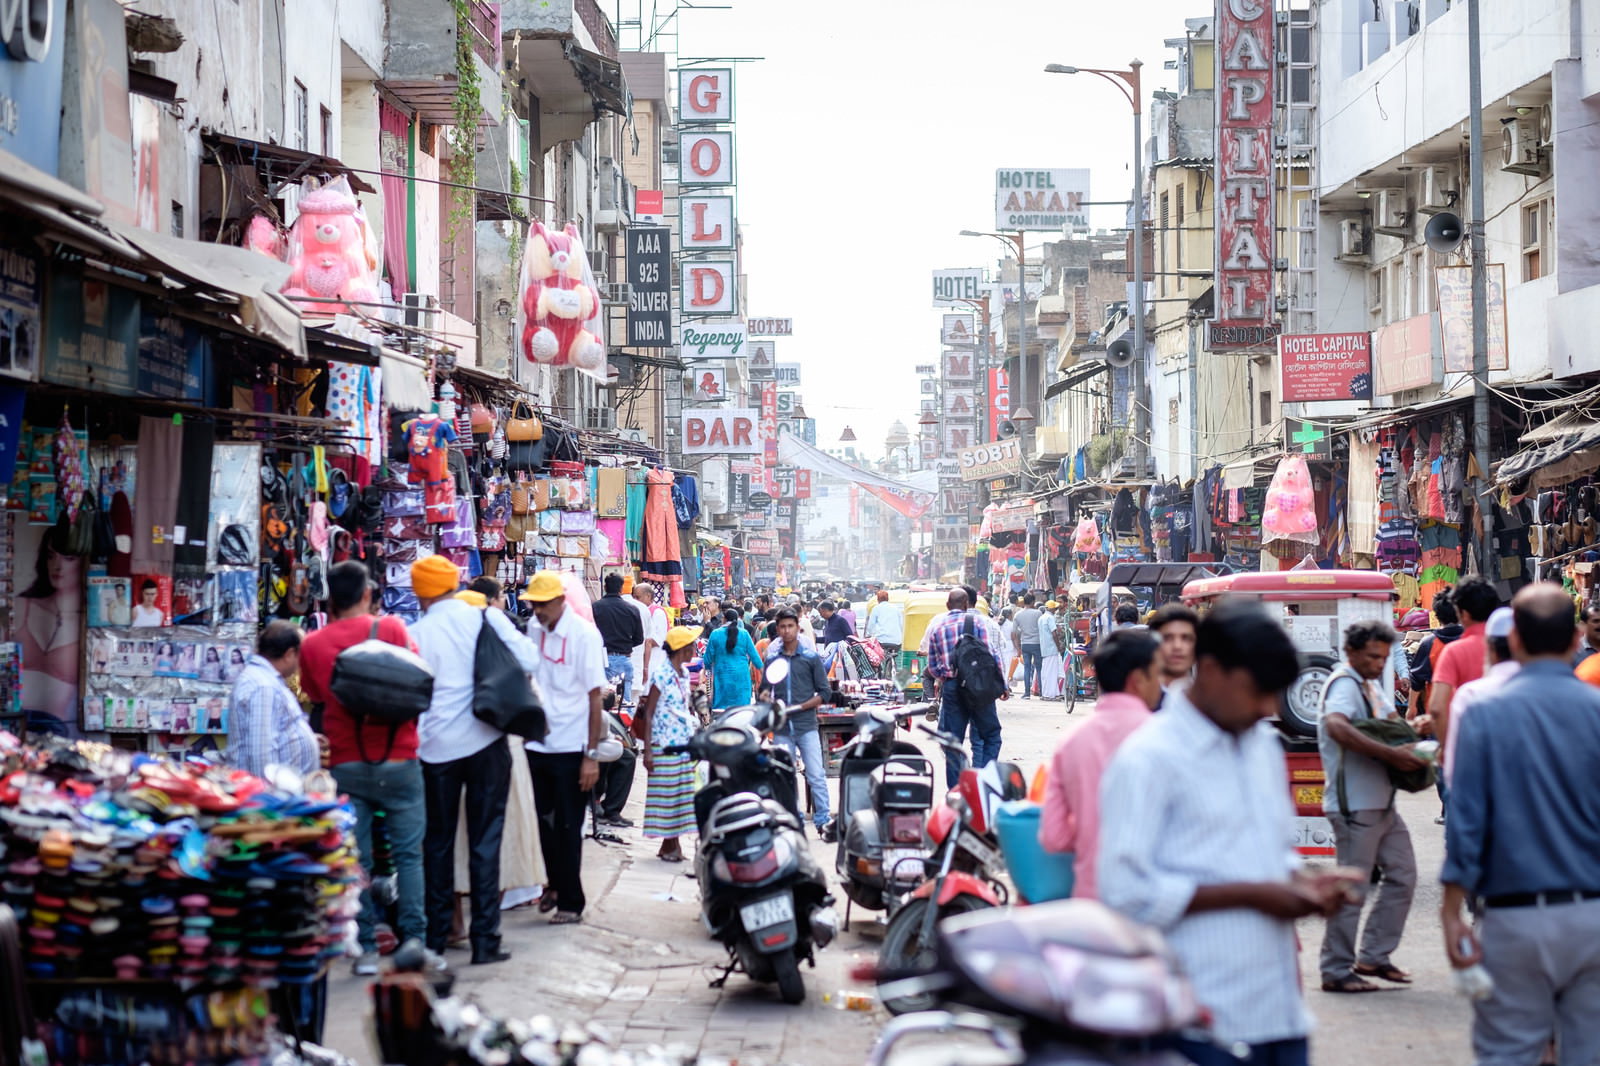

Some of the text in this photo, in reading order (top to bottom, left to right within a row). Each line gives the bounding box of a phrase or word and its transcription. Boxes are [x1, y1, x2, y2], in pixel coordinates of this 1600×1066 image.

[1224, 0, 1269, 319] CAPITAL
[999, 171, 1056, 188] HOTEL
[688, 75, 725, 306] GOLD
[1004, 191, 1083, 212] AMAN
[1009, 214, 1087, 226] CONTINENTAL
[636, 233, 661, 254] AAA
[639, 262, 660, 283] 925
[933, 276, 981, 299] HOTEL
[631, 291, 668, 312] SILVER
[634, 320, 665, 341] INDIA
[748, 319, 792, 334] HOTEL
[1211, 327, 1280, 345] RESIDENCY
[682, 328, 744, 354] Regency
[1284, 335, 1366, 353] HOTEL CAPITAL
[1296, 352, 1354, 361] RESIDENCY
[699, 372, 720, 395] &
[949, 319, 970, 448] AMAN
[762, 381, 775, 440] KIRAN
[686, 417, 753, 447] BAR
